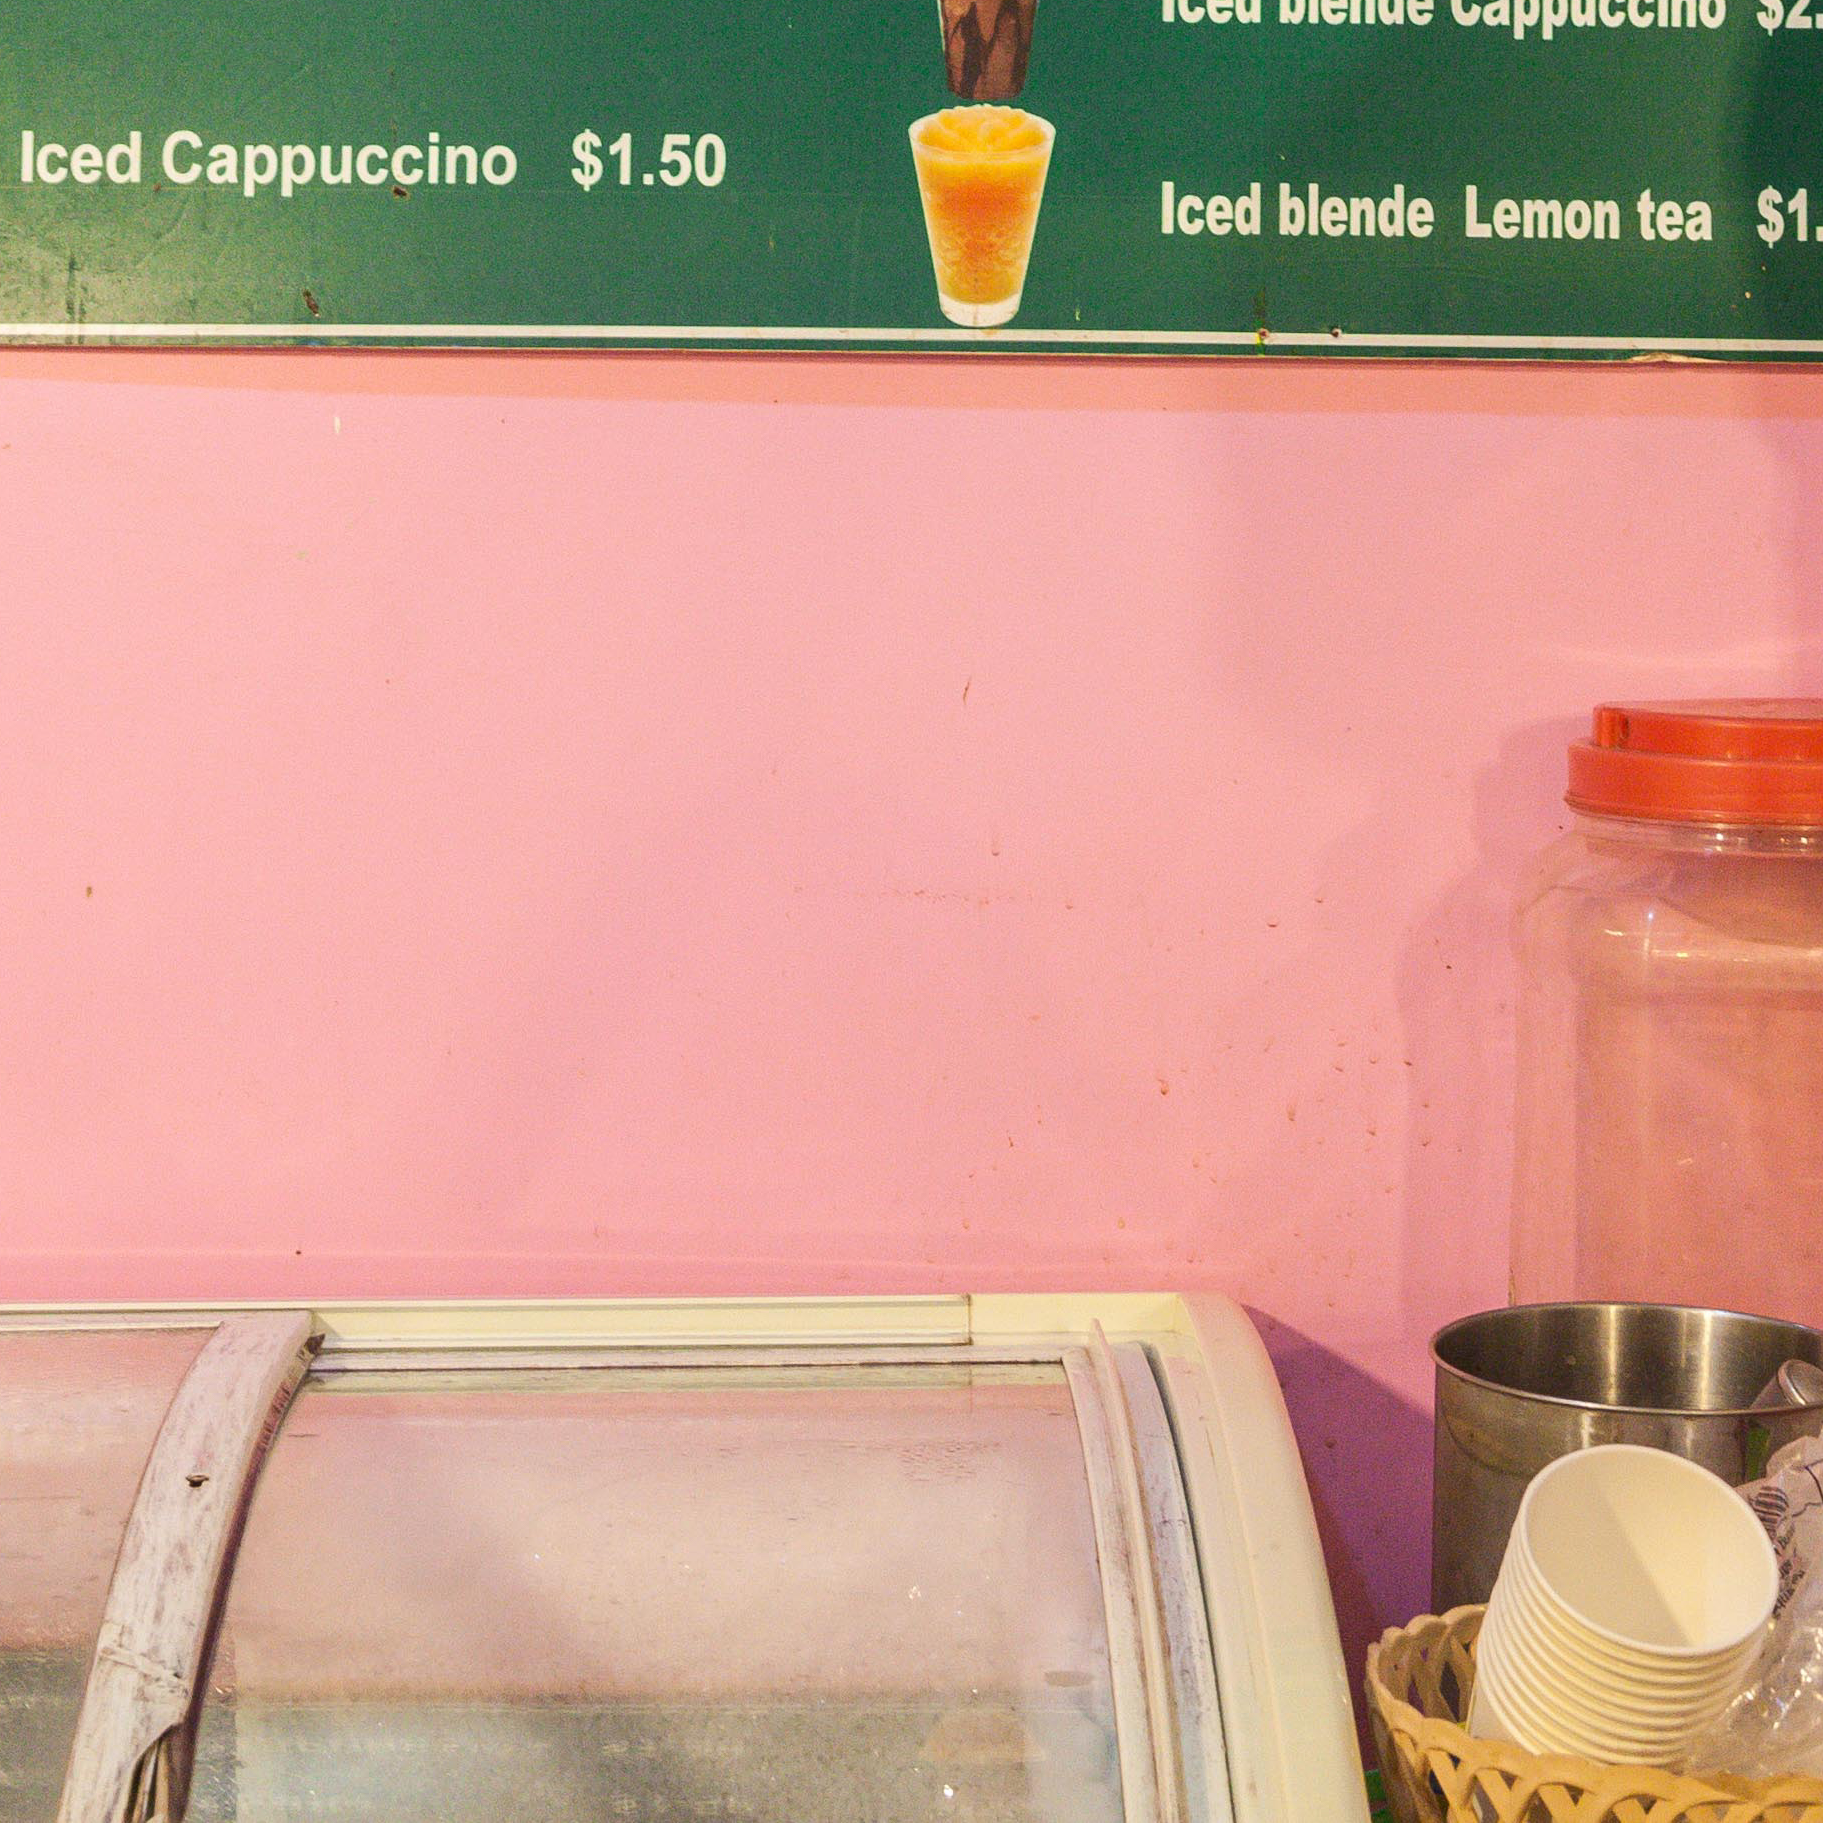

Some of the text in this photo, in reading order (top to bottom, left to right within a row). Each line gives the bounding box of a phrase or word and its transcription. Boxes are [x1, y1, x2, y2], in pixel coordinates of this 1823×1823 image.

[20, 130, 142, 186] Iced
[161, 130, 517, 198] Cappuccino
[572, 130, 725, 190] $1.50
[1161, 181, 1261, 236] Iced
[1279, 183, 1435, 238] blende
[1465, 185, 1620, 240] Lemon
[1636, 189, 1713, 242] tea
